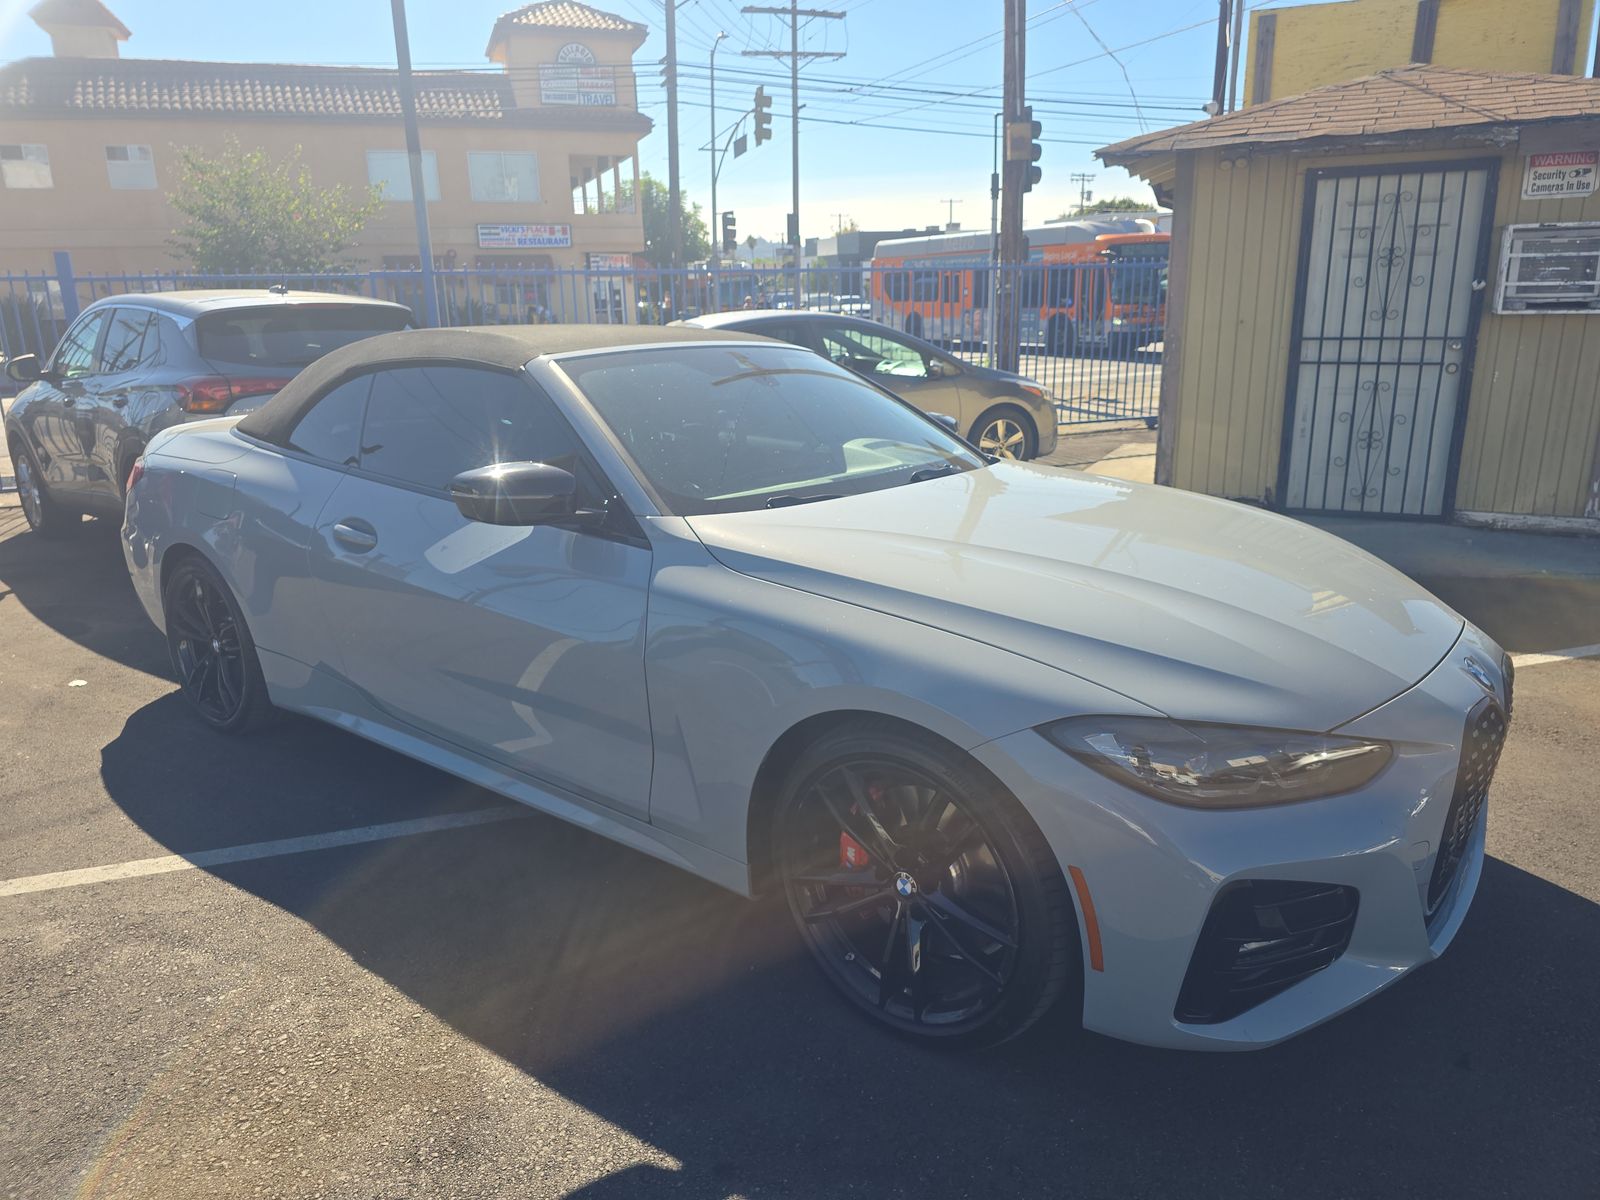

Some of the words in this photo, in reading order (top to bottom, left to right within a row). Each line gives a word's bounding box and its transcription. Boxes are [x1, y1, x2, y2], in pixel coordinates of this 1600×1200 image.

[1534, 152, 1595, 166] WARNING
[1532, 169, 1567, 181] Security
[1530, 182, 1564, 193] Cameras
[1576, 180, 1591, 190] Use
[526, 225, 547, 234] PLACE
[517, 237, 569, 246] RESTAURANT
